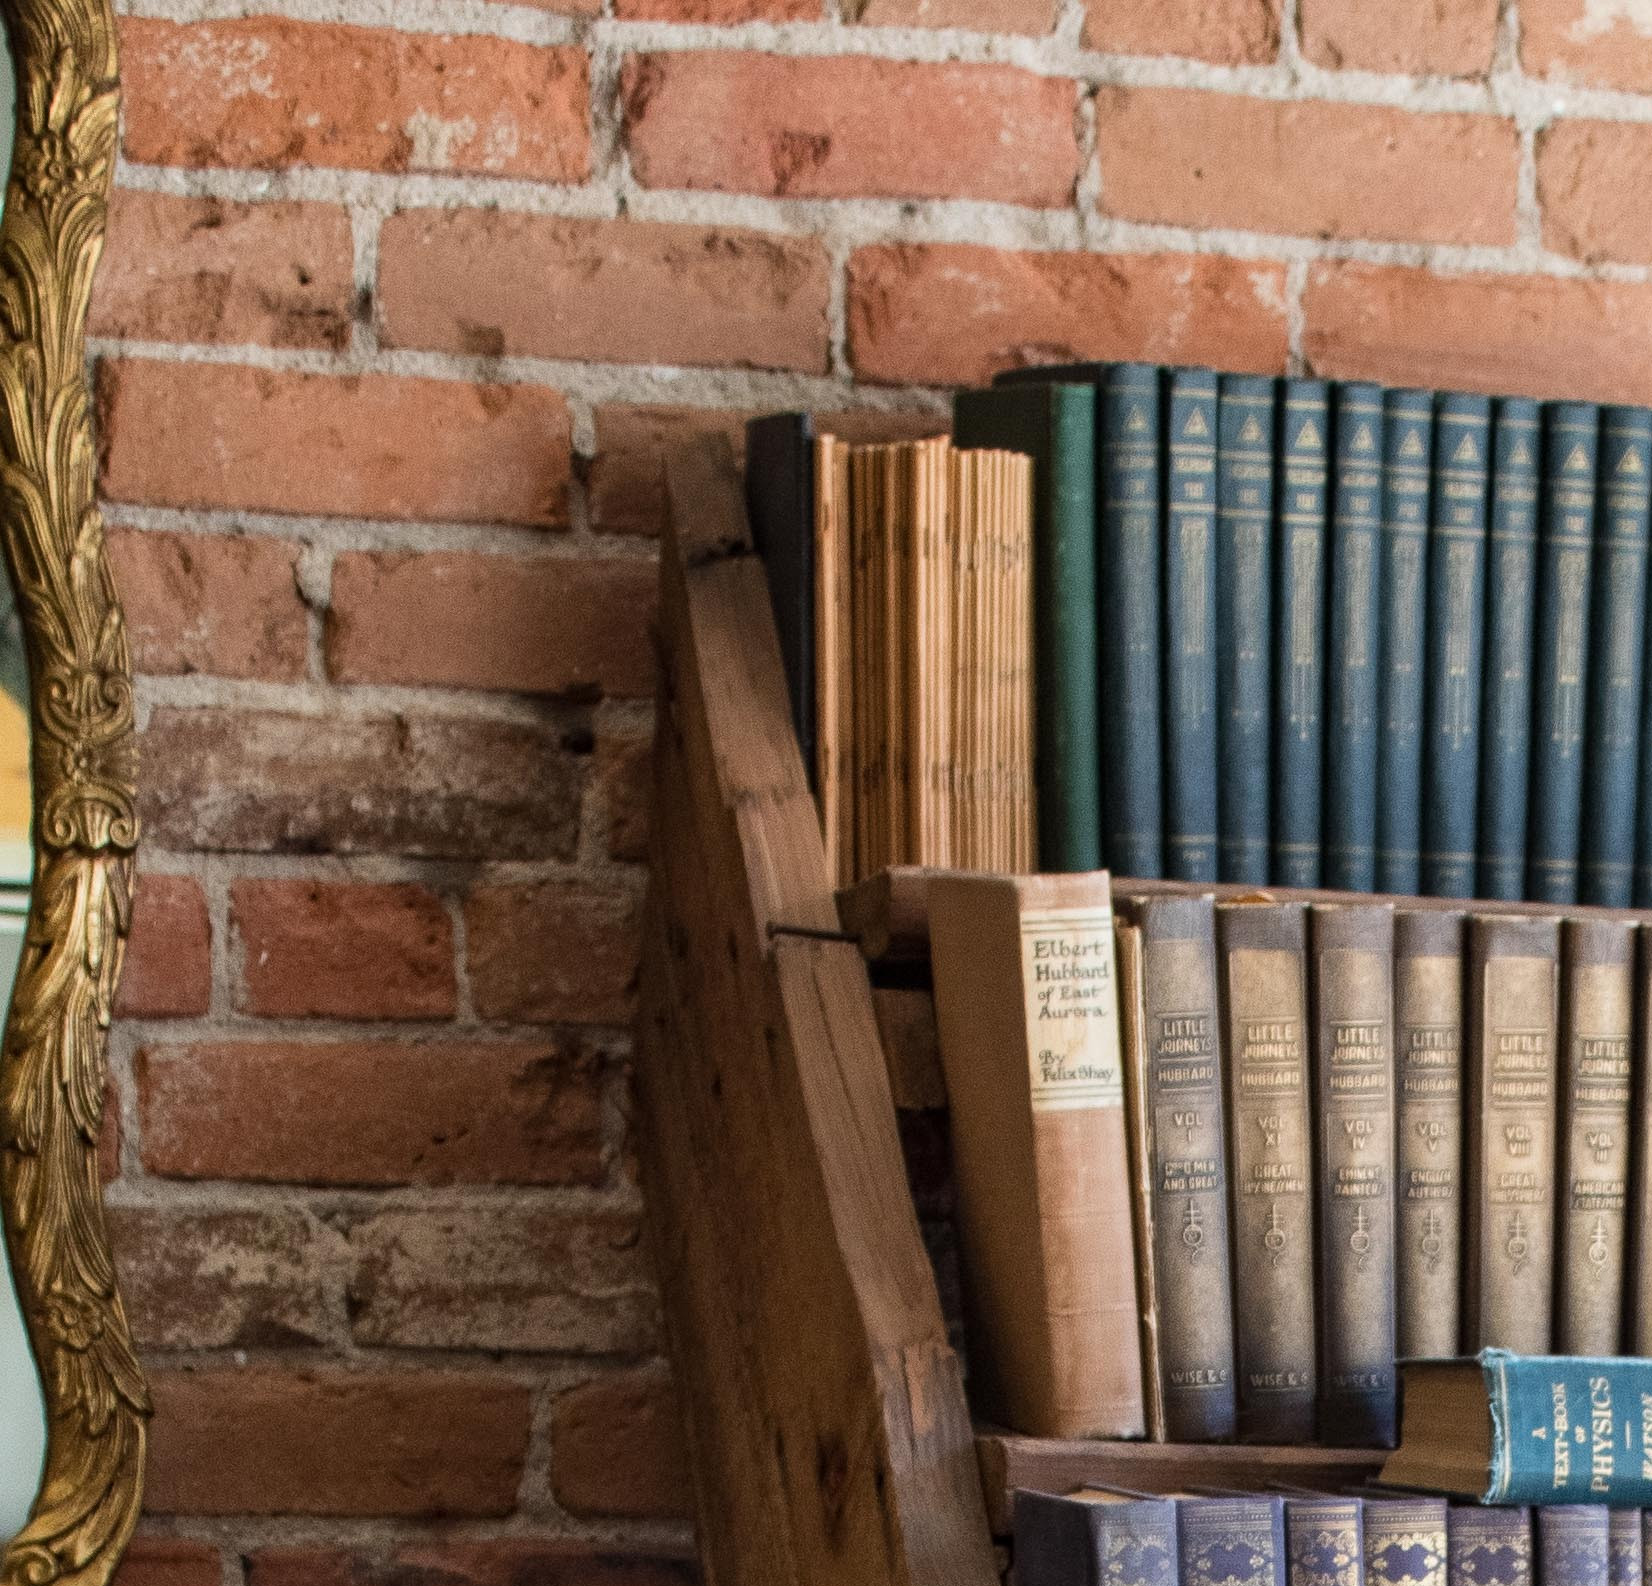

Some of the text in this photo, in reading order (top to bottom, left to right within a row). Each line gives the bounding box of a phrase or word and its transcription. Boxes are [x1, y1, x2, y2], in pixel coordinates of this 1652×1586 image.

[1034, 940, 1104, 959] Elbert
[1035, 963, 1109, 981] Hubbard
[1038, 985, 1107, 1000] of East
[1039, 1006, 1106, 1020] Aurora
[1164, 1021, 1206, 1036] LITTLE
[1248, 1024, 1292, 1039] LITTLE
[1338, 1028, 1379, 1044] LITTLE
[1158, 1039, 1212, 1054] JOURNEYS
[1501, 1036, 1543, 1051] LITTLE
[1039, 1049, 1065, 1065] By
[1042, 1066, 1114, 1083] Felix Shay
[1158, 1067, 1213, 1082] HUBBARD
[1242, 1071, 1299, 1085] HUBBARD
[1330, 1074, 1385, 1088] HUBBARD
[1532, 1426, 1546, 1439] A
[1552, 1383, 1569, 1488] TEXT-BOOK
[1590, 1377, 1613, 1492] PHYSICS
